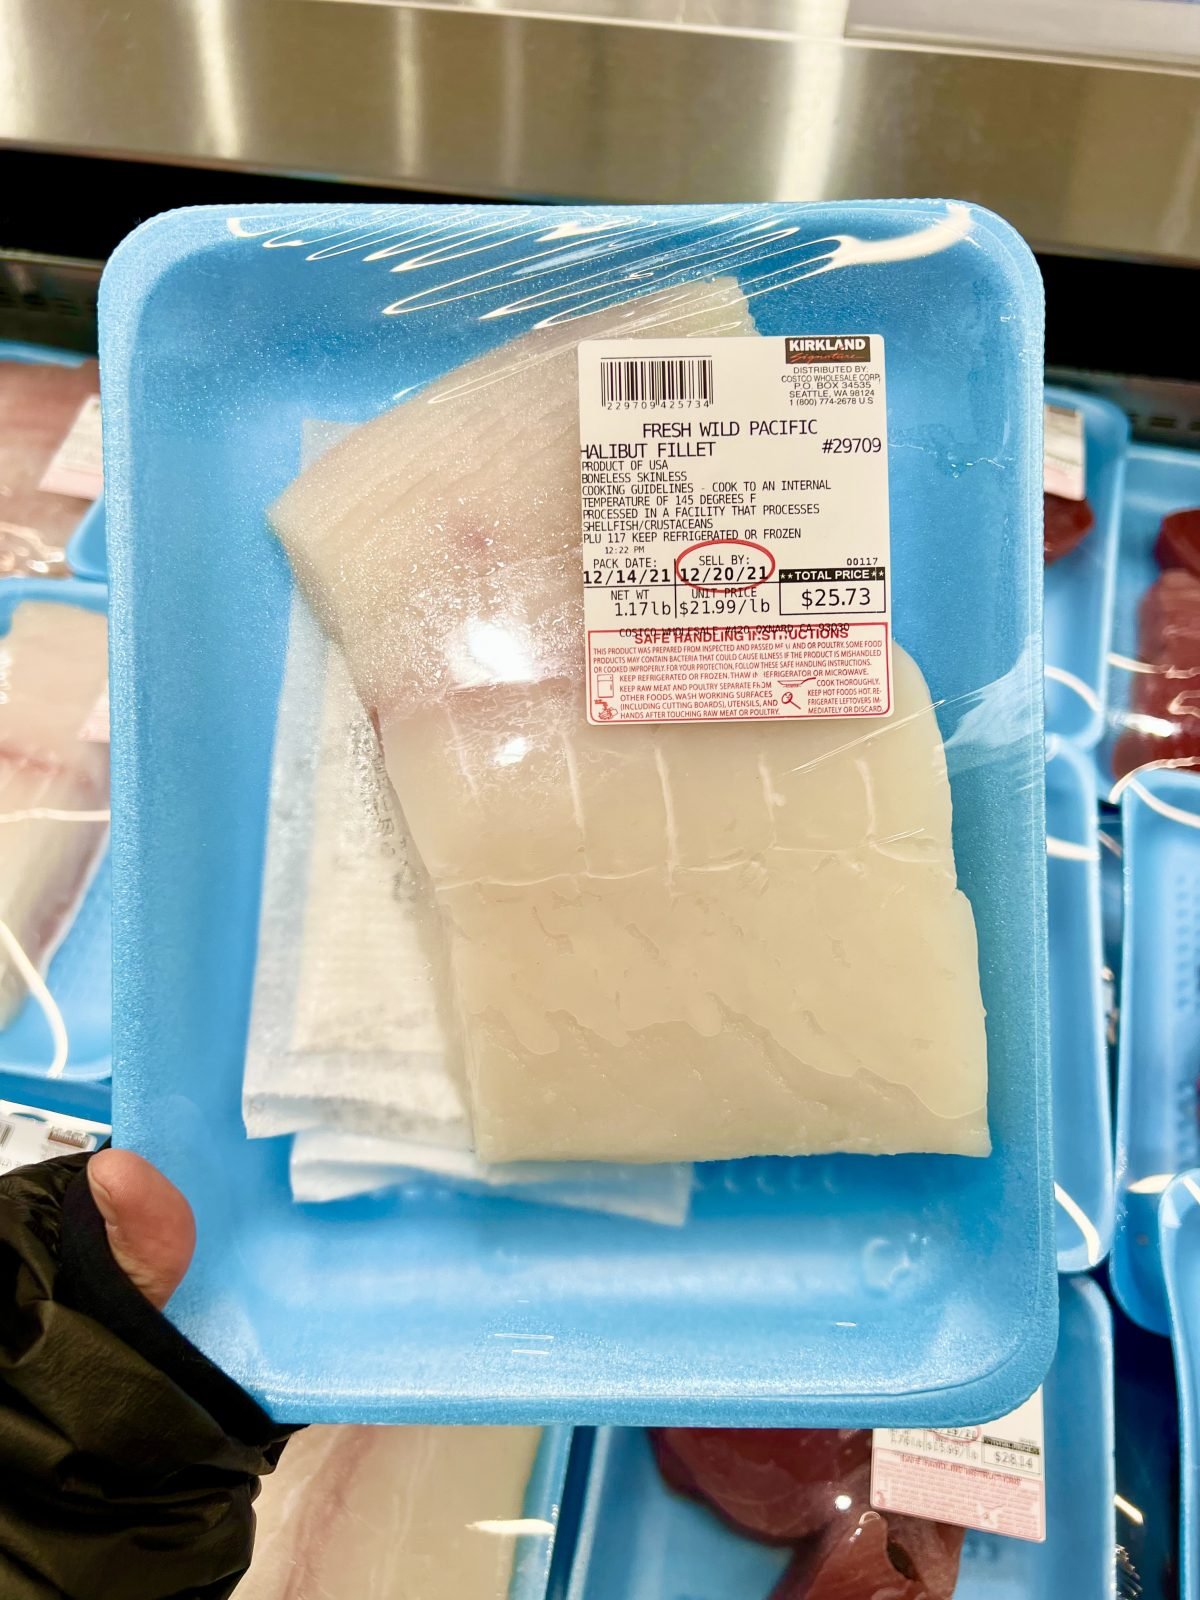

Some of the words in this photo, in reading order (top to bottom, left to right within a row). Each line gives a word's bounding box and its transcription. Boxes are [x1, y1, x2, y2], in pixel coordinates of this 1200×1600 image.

[789, 338, 865, 351] KIRKLAND
[789, 351, 864, 364] Signature
[793, 365, 852, 374] DISTRIBUTED
[854, 364, 868, 373] BY:
[813, 374, 857, 382] WHOLESALE
[789, 390, 831, 398] SEATTLE,
[833, 389, 847, 397] WA
[790, 398, 792, 406] 1
[796, 398, 816, 406] (800)
[819, 397, 856, 405] 774-2678
[643, 421, 691, 439] FRESH
[699, 420, 740, 437] WILD
[749, 418, 817, 436] PACIFIC
[579, 442, 648, 460] HALIBUT
[657, 440, 716, 458] FILLET
[821, 437, 881, 454] #29709
[581, 460, 624, 472] PRODUCT
[630, 460, 642, 471] OF
[649, 459, 668, 470] USA
[581, 472, 631, 484] BONELESS
[637, 471, 687, 482] SKINLESS
[581, 484, 625, 496] COOKING
[630, 483, 693, 495] GUIDELINES
[712, 482, 737, 493] COOK
[743, 481, 756, 492] TO
[762, 481, 775, 491] AN
[781, 479, 831, 491] INTERNAL
[582, 496, 650, 508] TEMPERATURE
[656, 495, 668, 506] OF
[676, 494, 693, 505] 145
[699, 493, 744, 505] DEGREES
[750, 493, 756, 504] F
[582, 508, 638, 520] PROCESSED
[645, 507, 656, 518] IN
[662, 507, 669, 518] A
[675, 506, 725, 517] FACILITY
[731, 505, 756, 516] THAT
[763, 503, 819, 515] PROCESSES
[582, 518, 713, 532] SHELLFISH/CRUSTACEANS
[583, 532, 601, 543] PLU
[608, 532, 625, 542] 117
[632, 531, 657, 542] KEEP
[663, 529, 738, 541] REFRIGERATED
[744, 528, 757, 539] OR
[763, 527, 801, 538] FROZEN
[605, 546, 628, 554] 12:22
[593, 558, 618, 569] PACK
[625, 557, 656, 568] DATE:
[698, 554, 724, 566] SELL
[731, 553, 749, 565] BY:
[846, 557, 877, 566] 00117
[583, 568, 670, 584] 12/14/21
[679, 565, 768, 582] 12/20/21
[794, 570, 833, 581] TOTAL
[835, 568, 869, 579] PRICE
[610, 589, 629, 601] NET
[635, 589, 649, 600] WT
[691, 587, 719, 599] UNIT
[724, 586, 757, 598] PRICE
[801, 587, 870, 609] $25.73
[615, 601, 670, 618] 1.17lb
[679, 598, 769, 616] $21.99/lb
[619, 627, 656, 638] COSTCO
[634, 633, 669, 644] SAFE
[674, 631, 743, 643] HANDLING
[593, 647, 606, 655] THIS
[607, 646, 636, 655] PRODUCT
[637, 646, 651, 654] WAS
[652, 645, 682, 654] PREPARED
[683, 644, 701, 653] FROM
[702, 643, 734, 652] INSPECTED
[736, 643, 749, 651] AND
[750, 642, 773, 651] PASSED
[807, 641, 816, 649] OR
[817, 640, 844, 649] POULTRY.
[845, 640, 863, 648] SOME
[864, 639, 882, 647] FOOD
[593, 656, 625, 665] PRODUCTS
[626, 656, 640, 664] MAY
[640, 655, 668, 663] CONTAIN
[669, 654, 697, 663] BACTERIA
[698, 654, 714, 662] THAT
[715, 653, 737, 661] COULD
[738, 652, 758, 660] CAUSE
[790, 651, 802, 659] THE
[803, 650, 832, 658] PRODUCT
[840, 648, 881, 657] MISHANDLED
[593, 666, 602, 674] OR
[603, 665, 628, 674] COOKED
[629, 664, 665, 673] IMPROPERLY.
[666, 664, 678, 672] FOR
[678, 663, 695, 671] YOUR
[696, 662, 734, 671] PROTECTION,
[734, 661, 759, 670] FOLLOW
[760, 661, 778, 669] THESE
[779, 660, 793, 668] SAFE
[795, 659, 826, 668] HANDLING
[827, 658, 871, 667] INSTRUCTIONS.
[619, 674, 636, 682] KEEP
[637, 673, 687, 682] REFRIGERATED
[688, 672, 698, 680] OR
[700, 671, 729, 680] FROZEN.
[730, 671, 751, 679] THAW
[824, 667, 868, 676] MICROWAVE.
[636, 684, 652, 692] RAW
[672, 683, 687, 691] AND
[688, 682, 717, 690] POULTRY
[719, 681, 750, 689] SEPARATE
[620, 694, 644, 702] OTHER
[674, 692, 696, 700] WASH
[698, 691, 734, 699] WORKING
[736, 690, 772, 698] SURFACES
[620, 702, 660, 711] (INCLUDING
[662, 701, 692, 709] CUTTING
[727, 699, 761, 707] UTENSILS,
[620, 711, 643, 719] HANDS
[645, 711, 665, 719] AFTER
[667, 709, 701, 718] TOUCHING
[703, 709, 718, 717] RAW
[719, 708, 737, 716] MEAT
[738, 708, 748, 716] OR
[749, 707, 779, 715] POULTRY.
